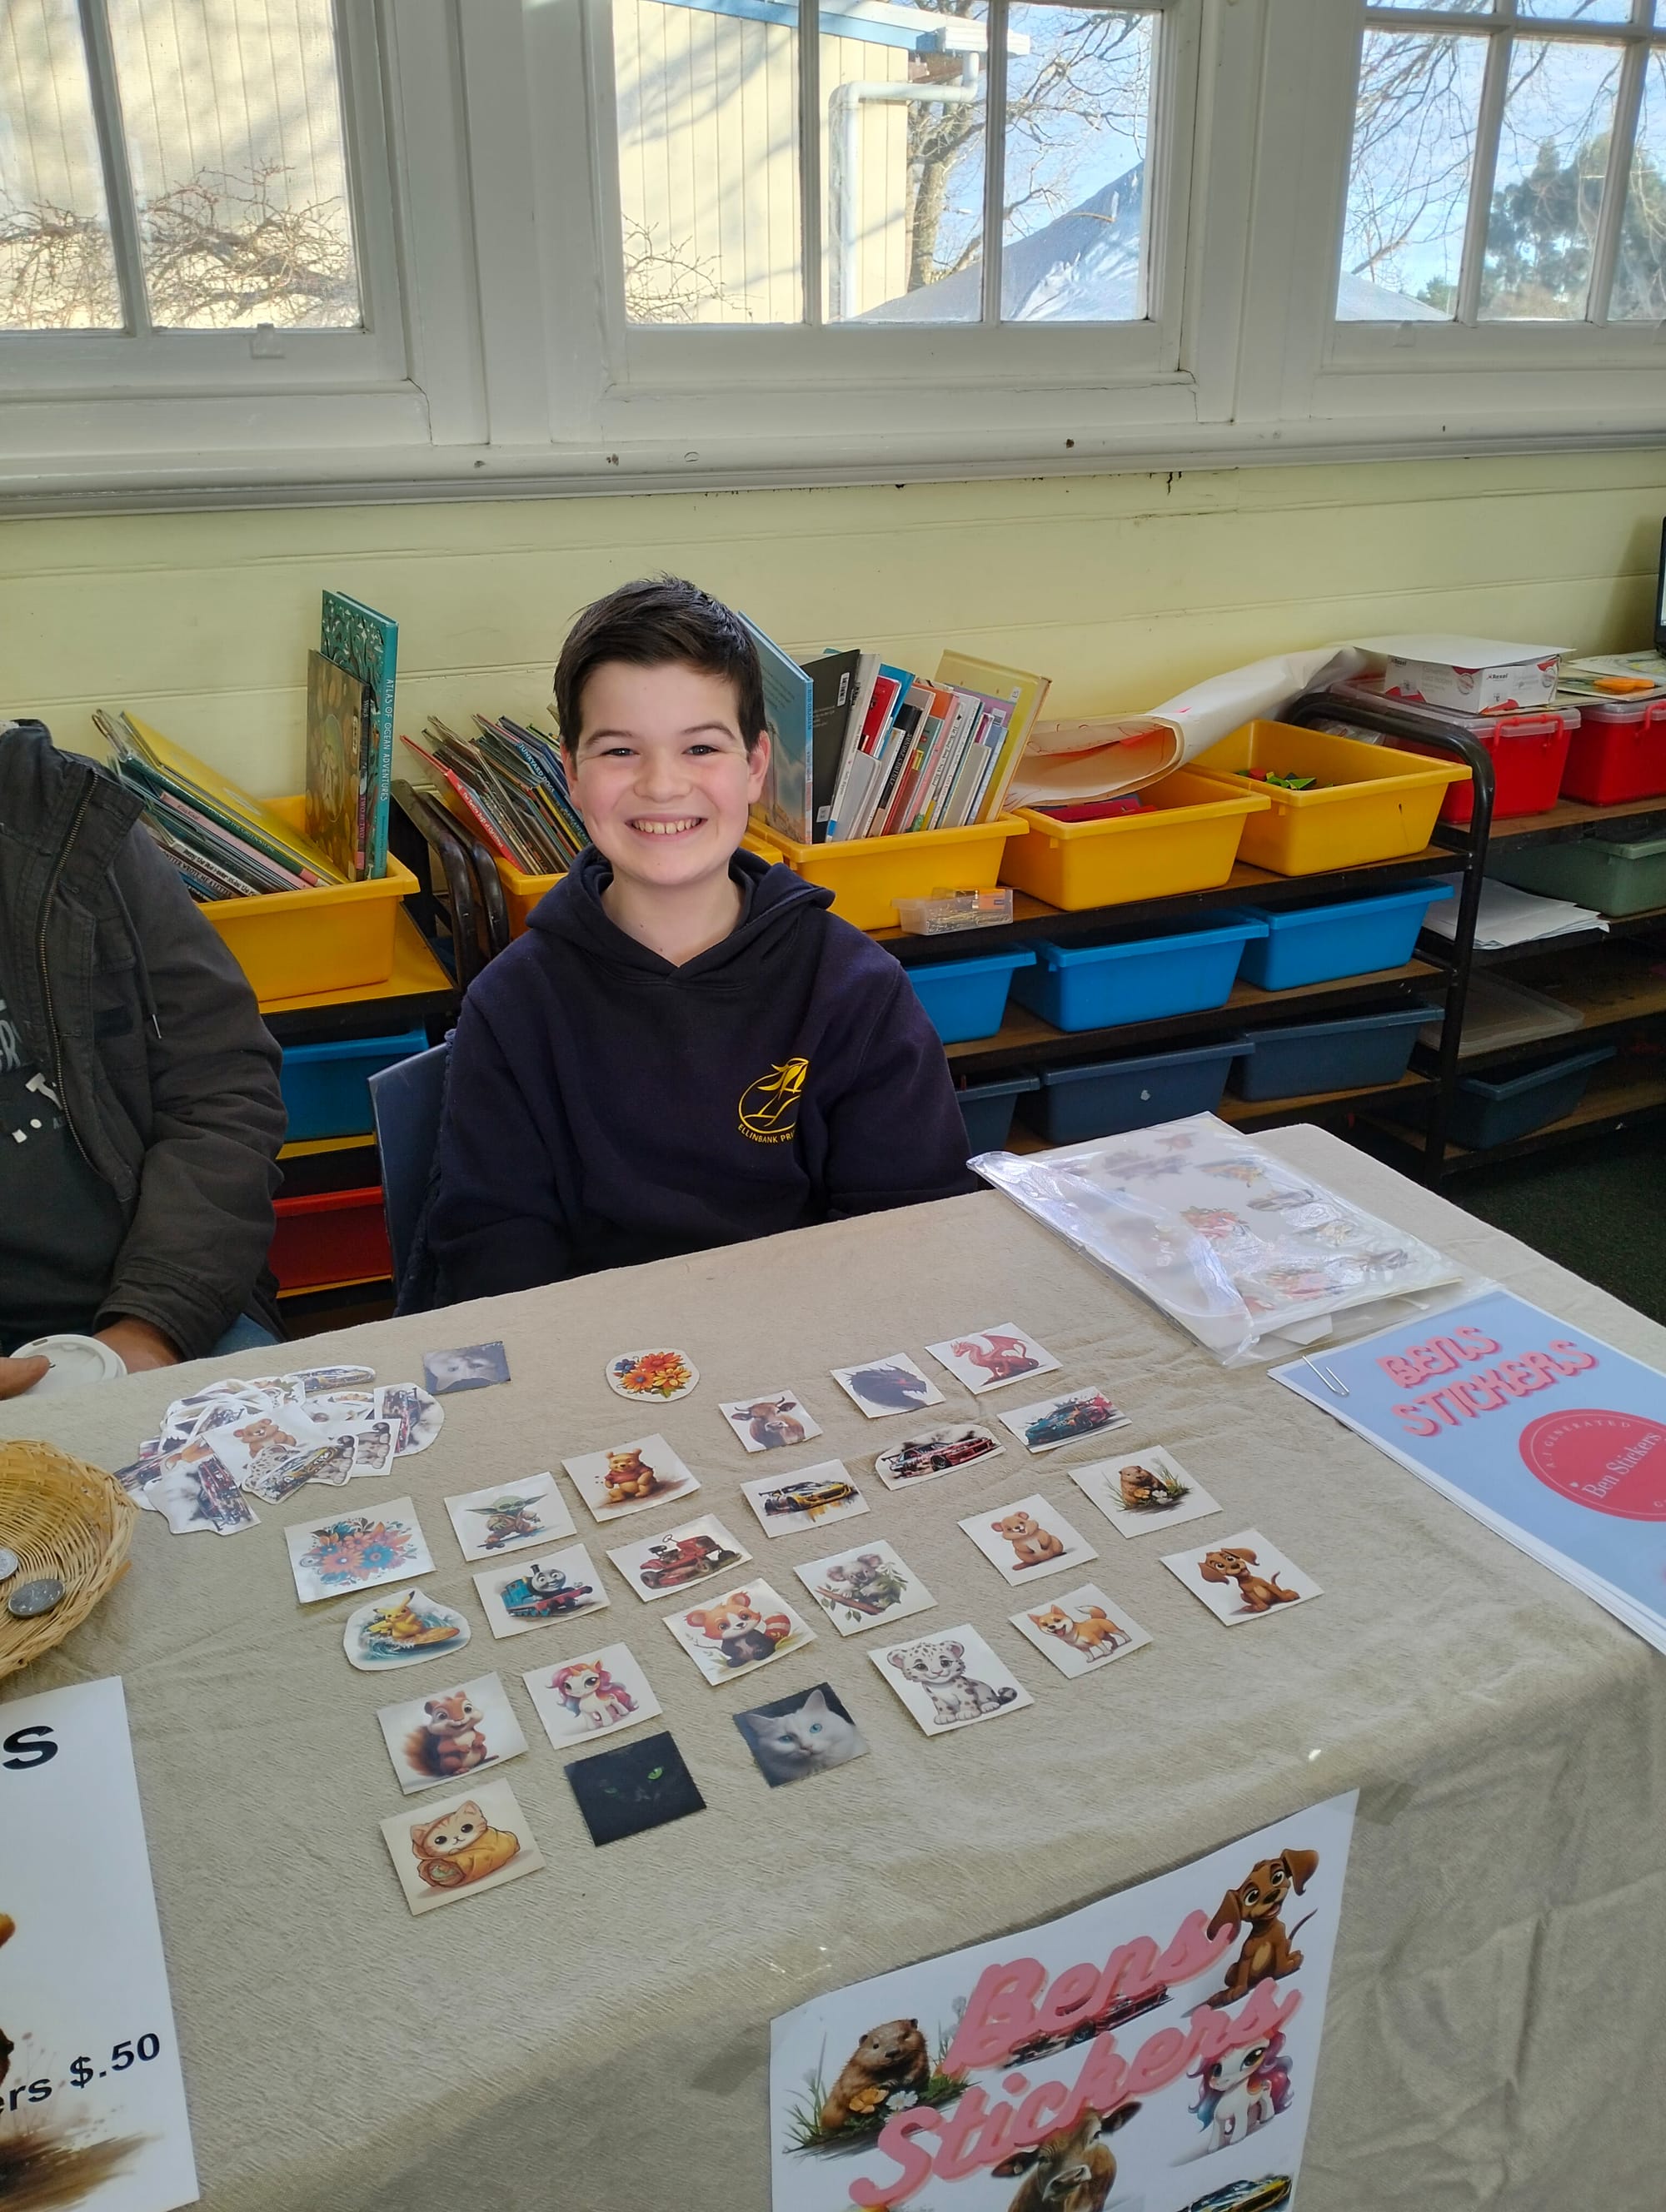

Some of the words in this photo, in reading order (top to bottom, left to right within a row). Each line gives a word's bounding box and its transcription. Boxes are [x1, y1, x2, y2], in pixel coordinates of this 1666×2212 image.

[385, 679, 394, 704] ATLAS
[385, 706, 393, 718] OF
[383, 722, 392, 750] OCEAN
[519, 743, 544, 776] JUNKYARD
[380, 753, 392, 801] ADVENTURES
[737, 1123, 778, 1143] ELLINBANK
[780, 1129, 796, 1143] PRI
[1376, 1326, 1502, 1389] BENS
[1391, 1339, 1599, 1437] STICKERS
[1544, 1419, 1631, 1447] GENERATED
[1582, 1474, 1620, 1498] Ben
[1606, 1432, 1662, 1474] Stickers
[941, 1910, 1236, 2080] Bens
[0, 2078, 52, 2115] rs
[69, 2033, 160, 2089] $.50
[848, 1978, 1304, 2209] Stickers
